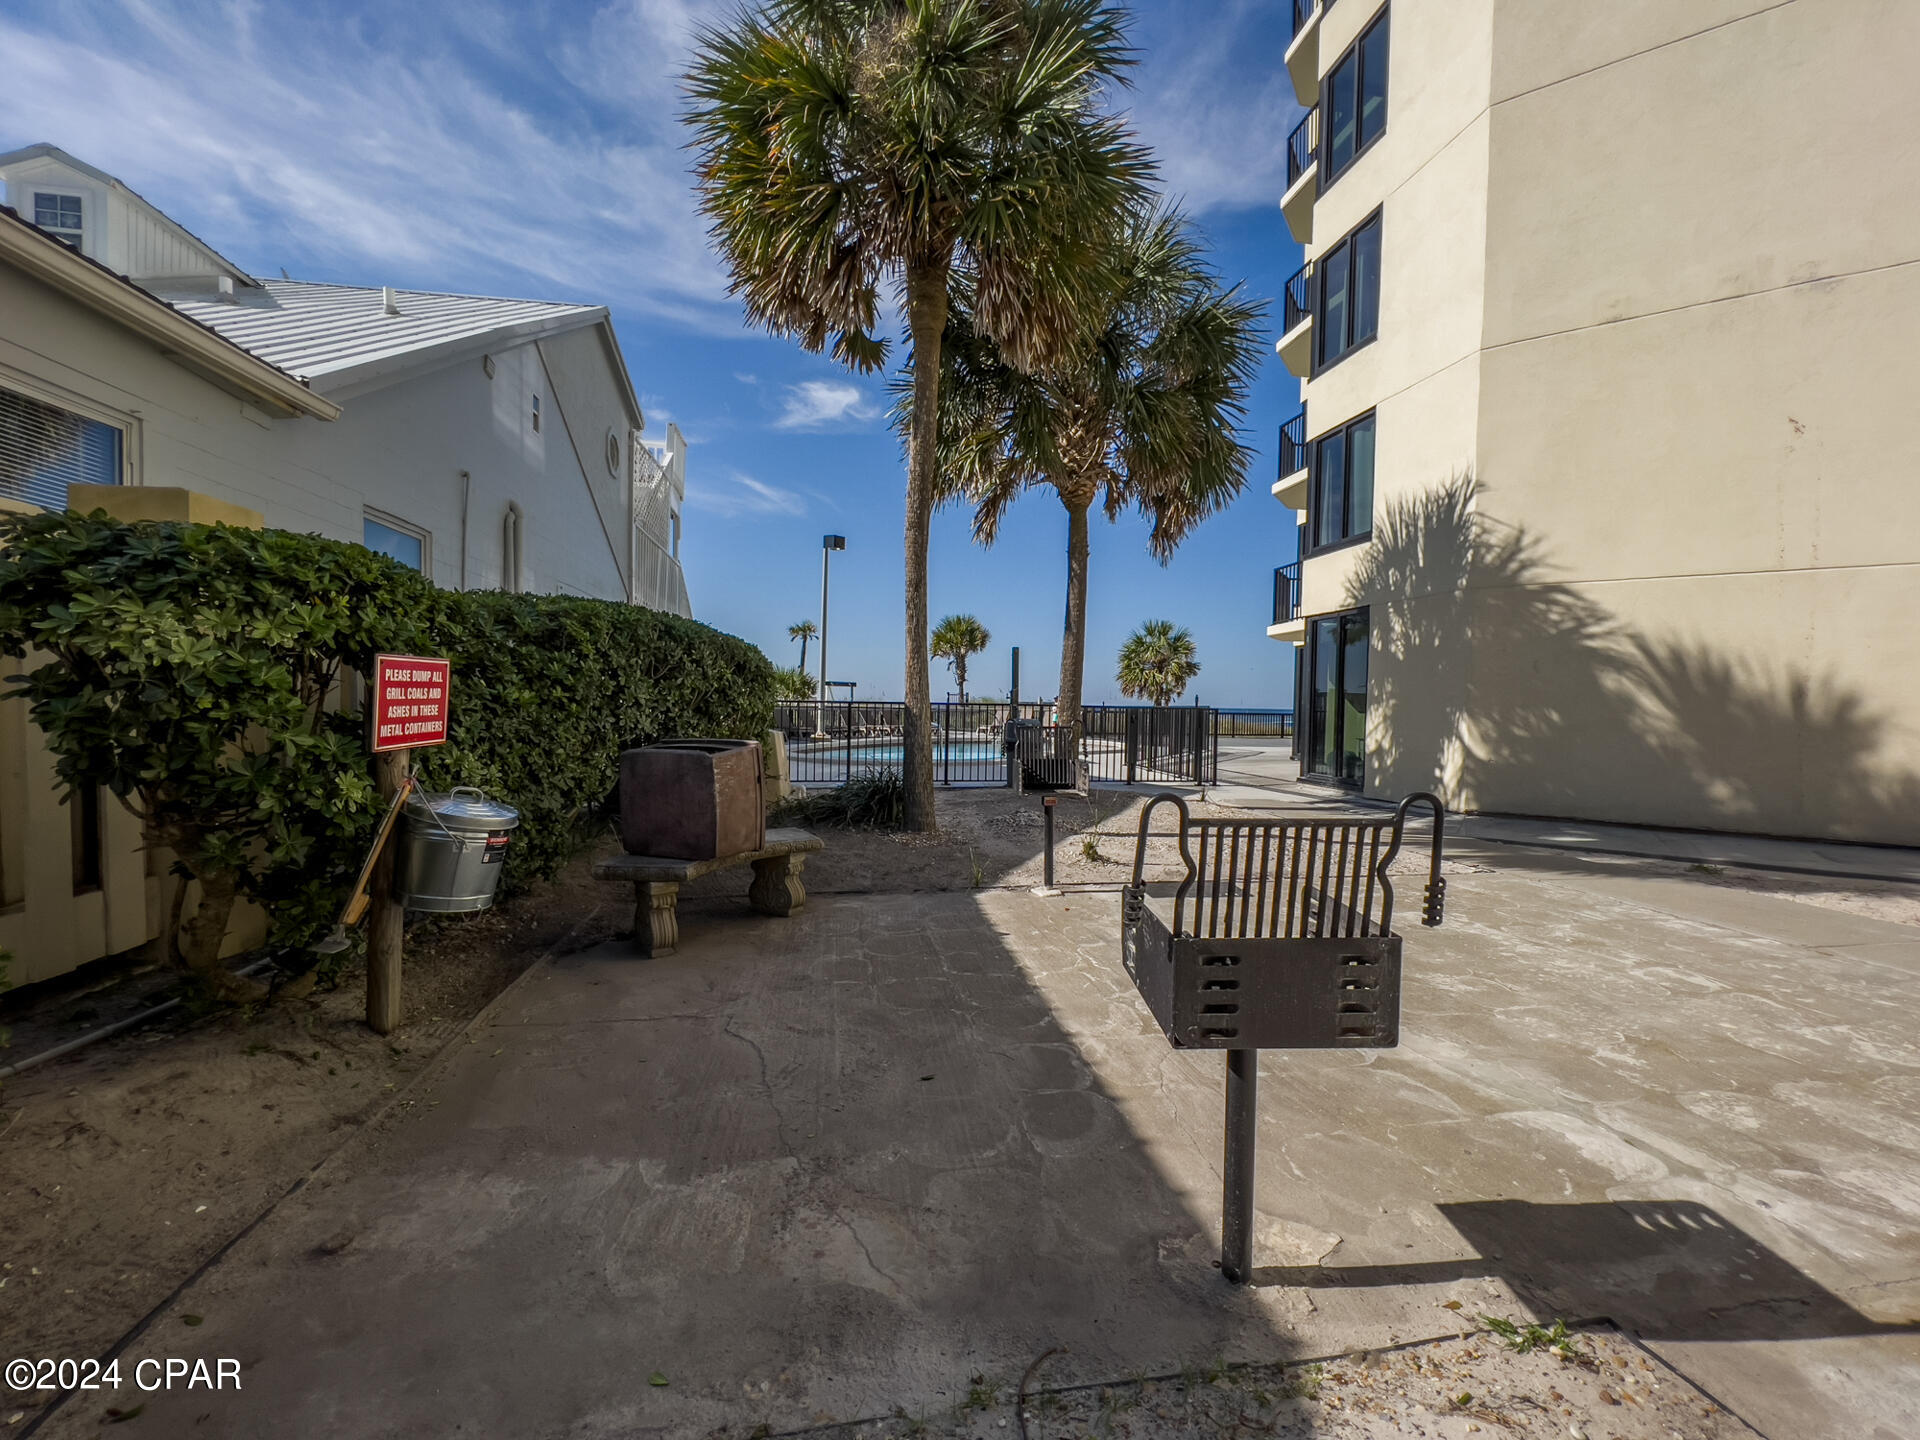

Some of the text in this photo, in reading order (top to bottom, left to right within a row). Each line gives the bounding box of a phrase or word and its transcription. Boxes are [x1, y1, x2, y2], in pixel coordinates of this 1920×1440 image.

[385, 669, 443, 682] PLEASE DUMP ALL
[386, 687, 441, 700] GRILL COALS AND
[388, 704, 439, 718] ASHES IN THESE
[380, 721, 443, 737] METAL CONTAINERS
